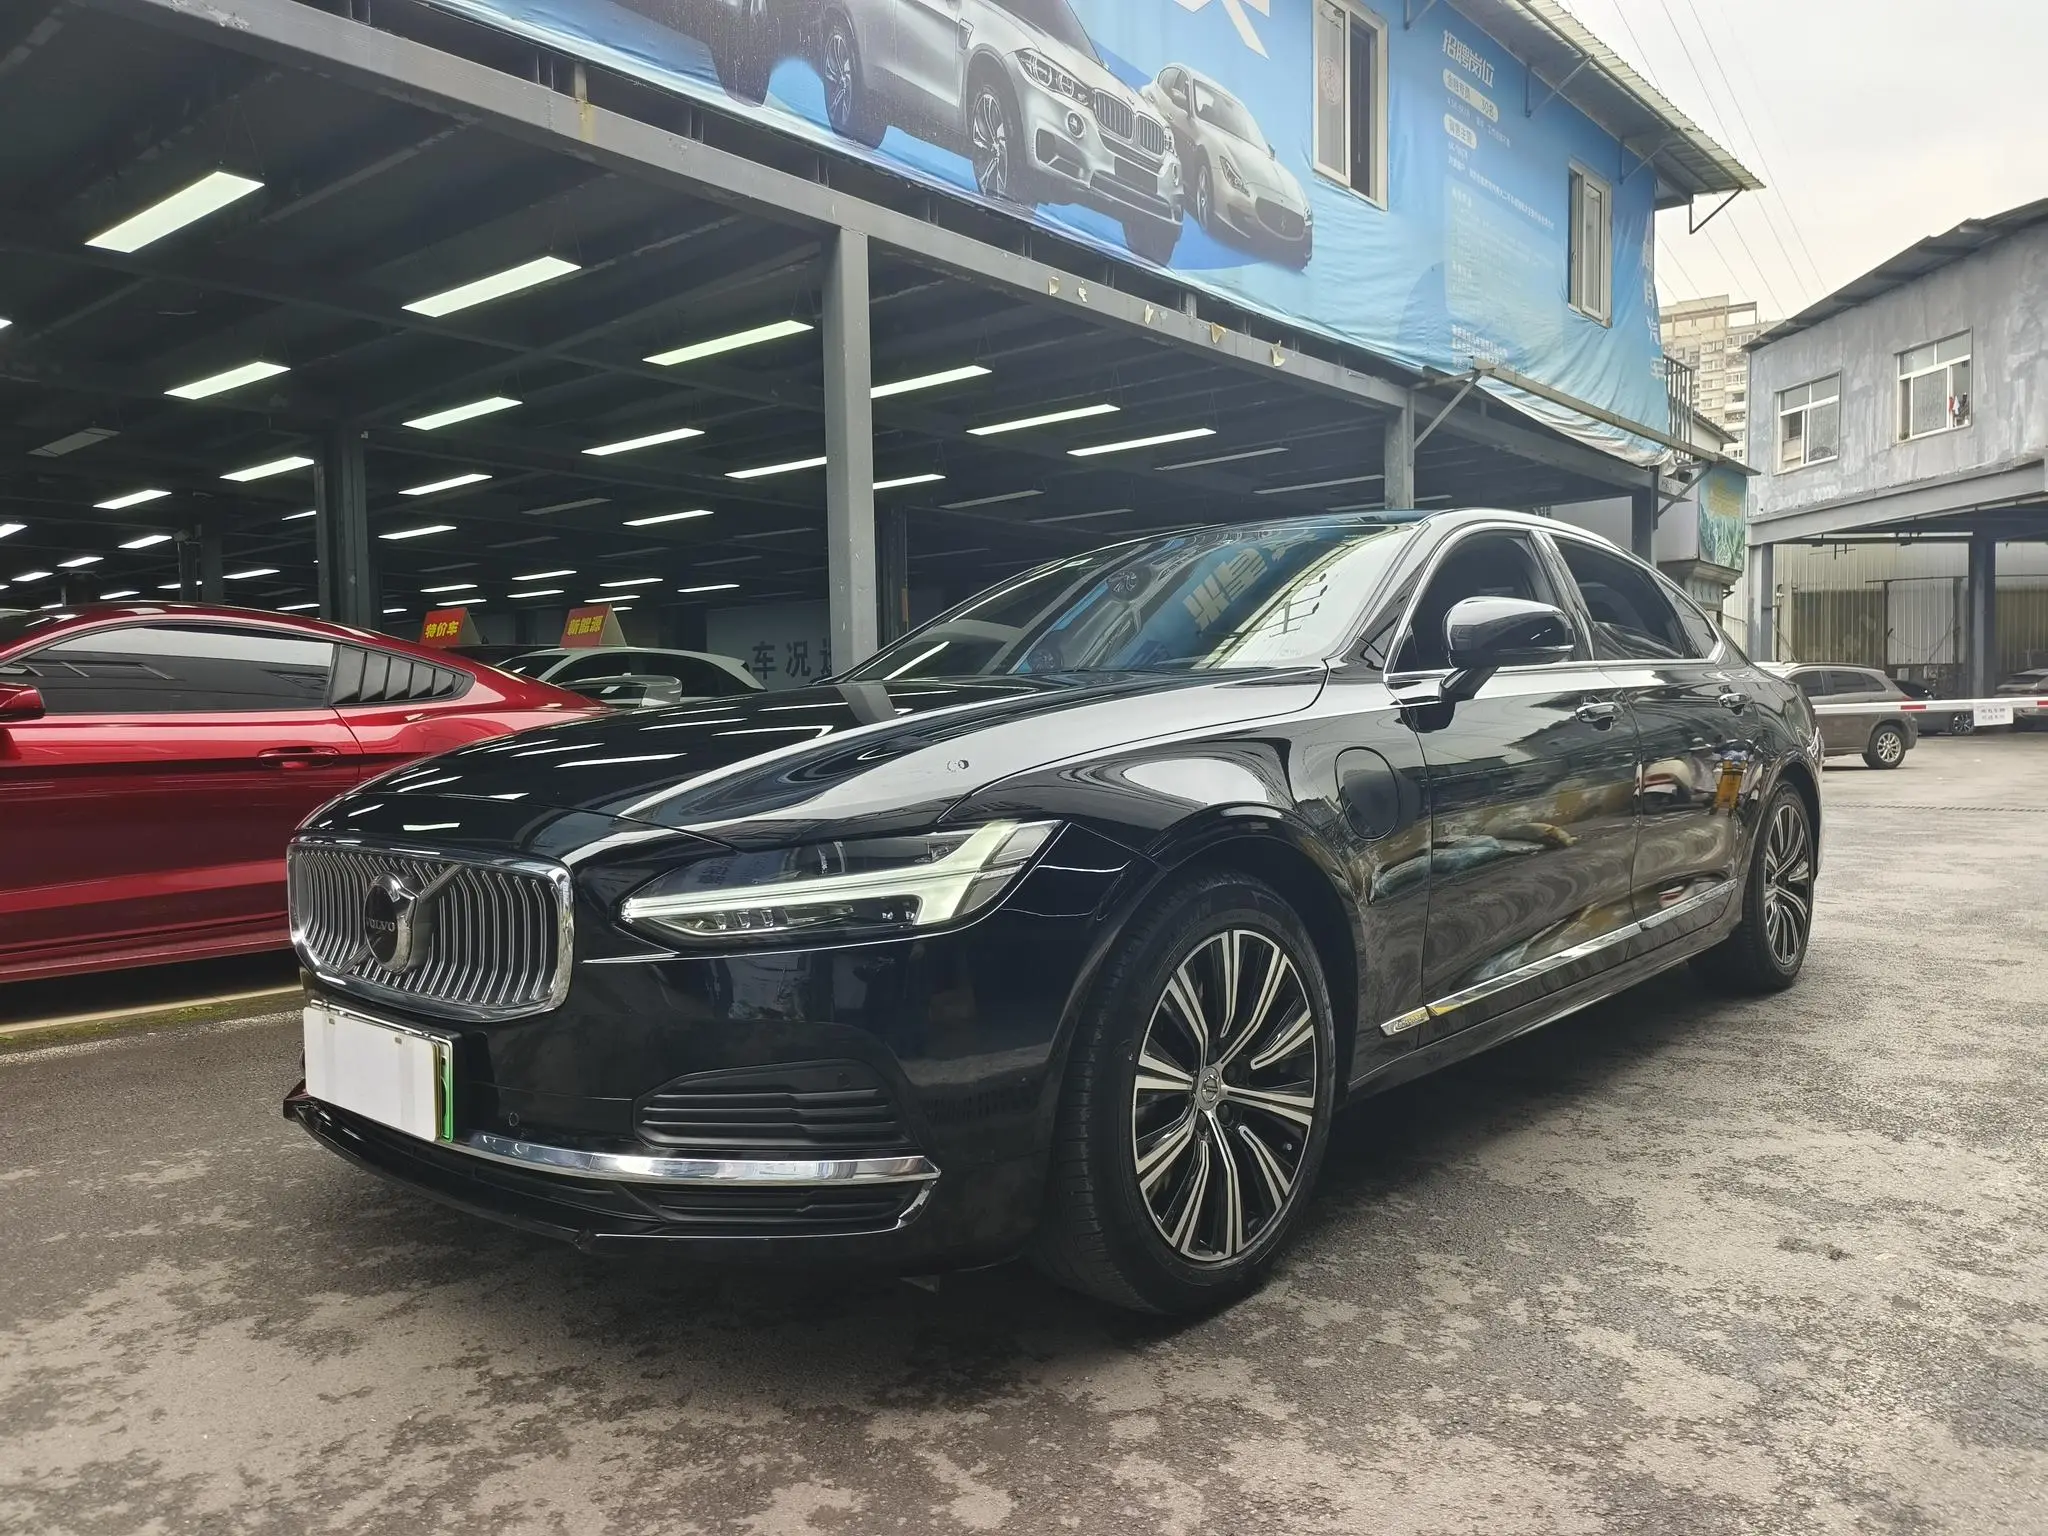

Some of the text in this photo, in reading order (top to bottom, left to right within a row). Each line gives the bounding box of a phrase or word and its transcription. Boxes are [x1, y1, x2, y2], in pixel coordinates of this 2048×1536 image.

[1442, 29, 1495, 89] 招聘岗位
[425, 620, 459, 638] 特价车
[566, 615, 604, 636] 新能源
[366, 918, 395, 932] VOLVO
